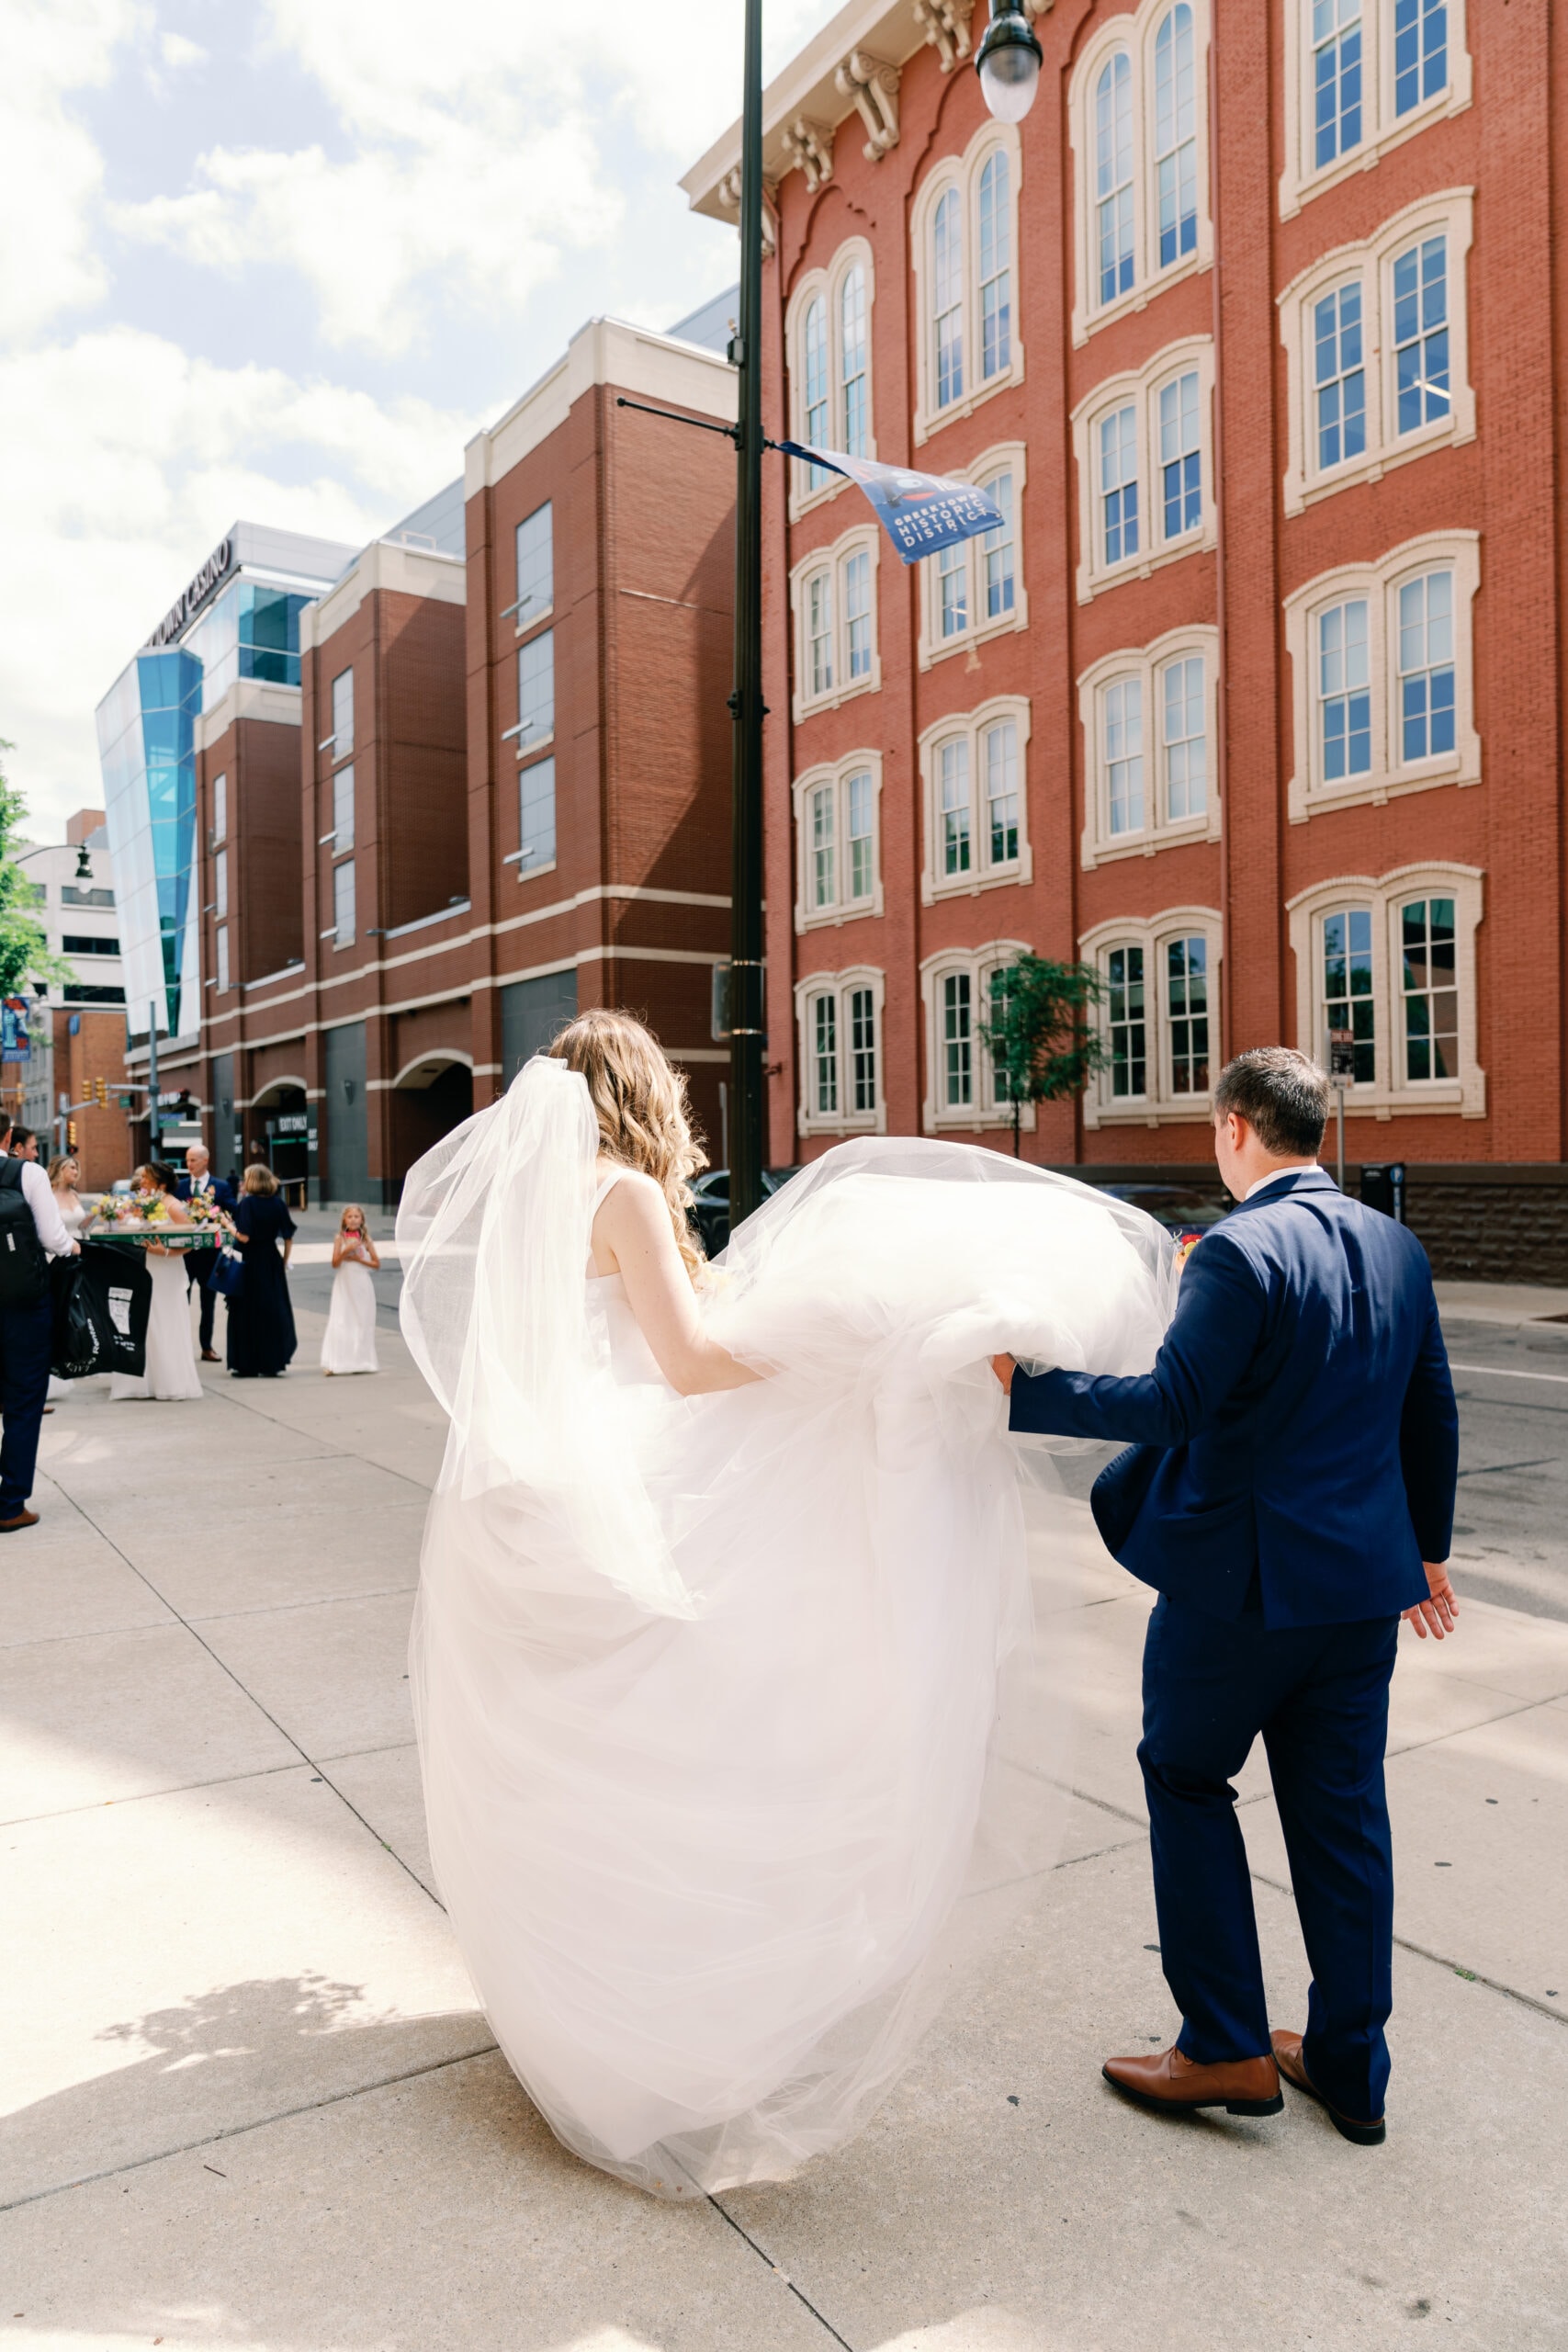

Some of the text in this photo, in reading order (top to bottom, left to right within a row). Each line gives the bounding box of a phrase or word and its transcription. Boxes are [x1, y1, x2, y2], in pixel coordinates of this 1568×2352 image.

[895, 492, 978, 526] GREEKTOWN
[898, 498, 983, 537] HISTORIC
[903, 506, 987, 548] DISTRICT
[186, 537, 231, 611] CASINO
[292, 1114, 308, 1131] ONLY
